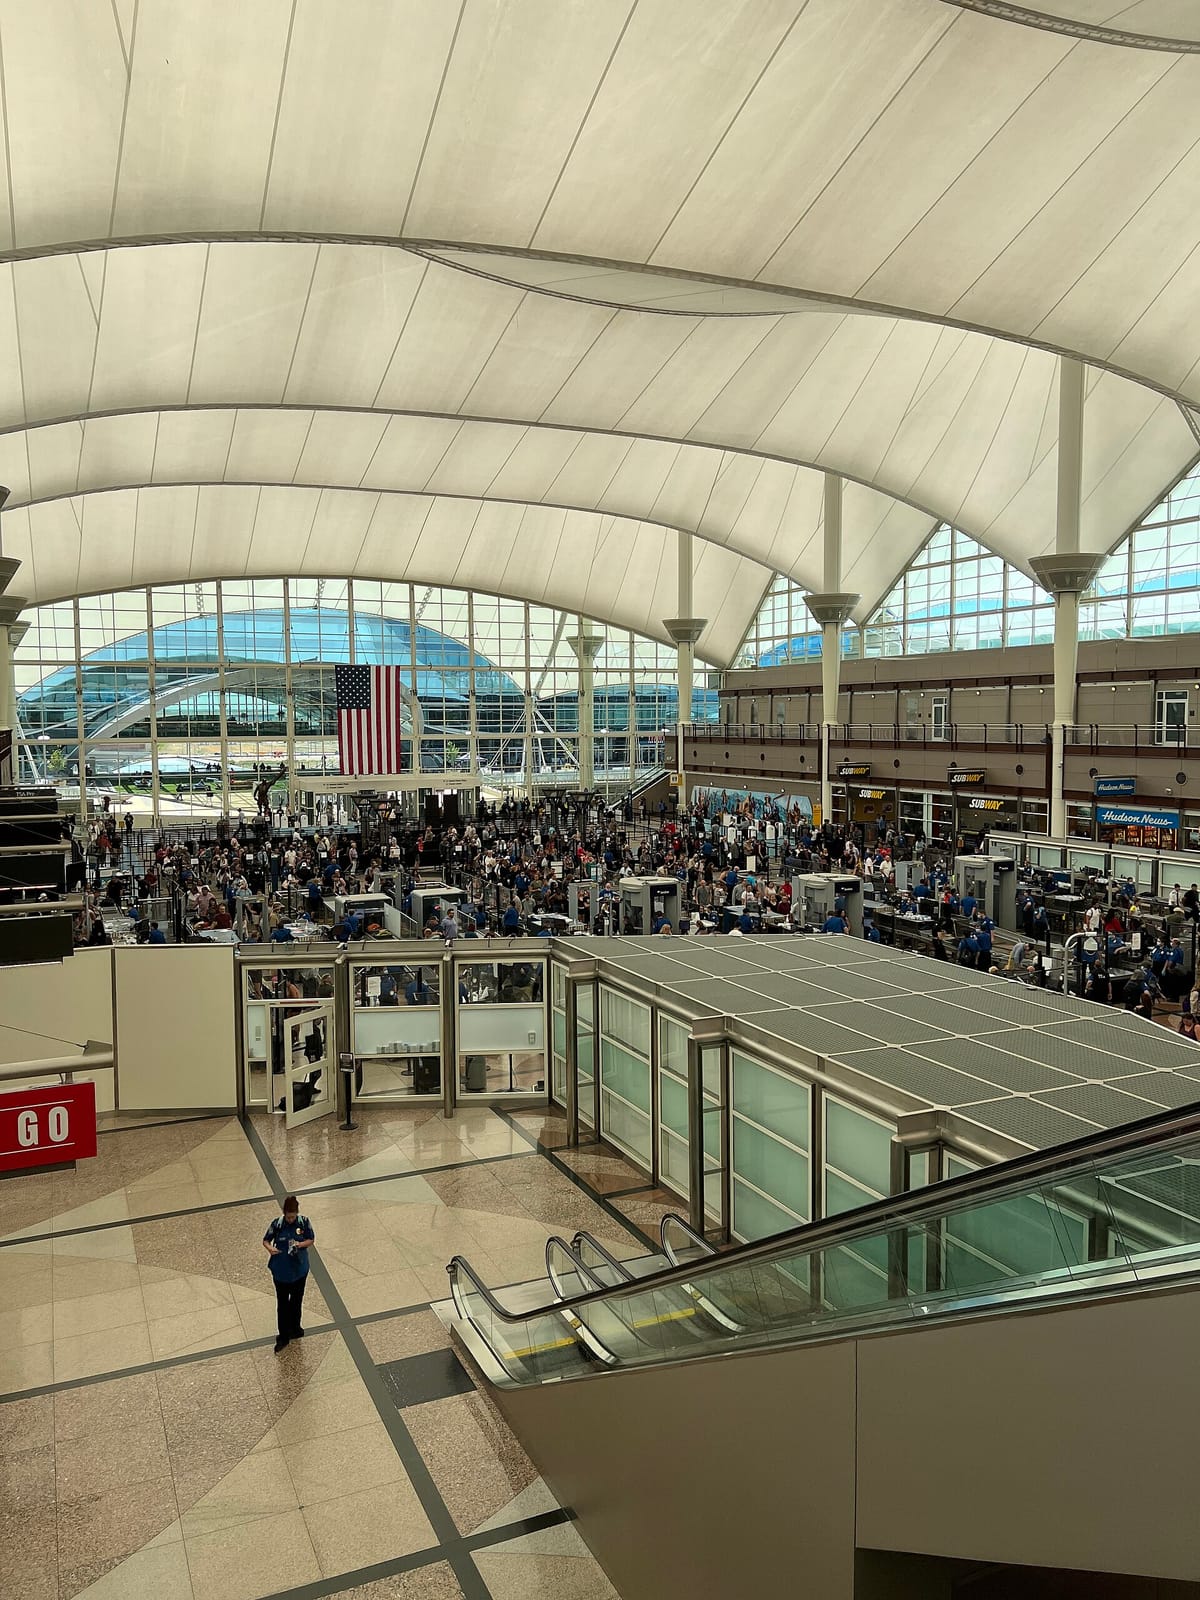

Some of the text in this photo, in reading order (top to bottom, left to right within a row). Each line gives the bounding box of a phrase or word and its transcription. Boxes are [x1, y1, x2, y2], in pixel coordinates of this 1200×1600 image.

[840, 767, 870, 775] SUBWAY
[951, 774, 984, 783] SUBWAY
[1098, 783, 1120, 791] Hudson
[859, 789, 886, 800] SUBWAY
[969, 798, 1004, 810] SUBWAY
[1101, 810, 1173, 825] Hudson News
[17, 1105, 69, 1147] GO
